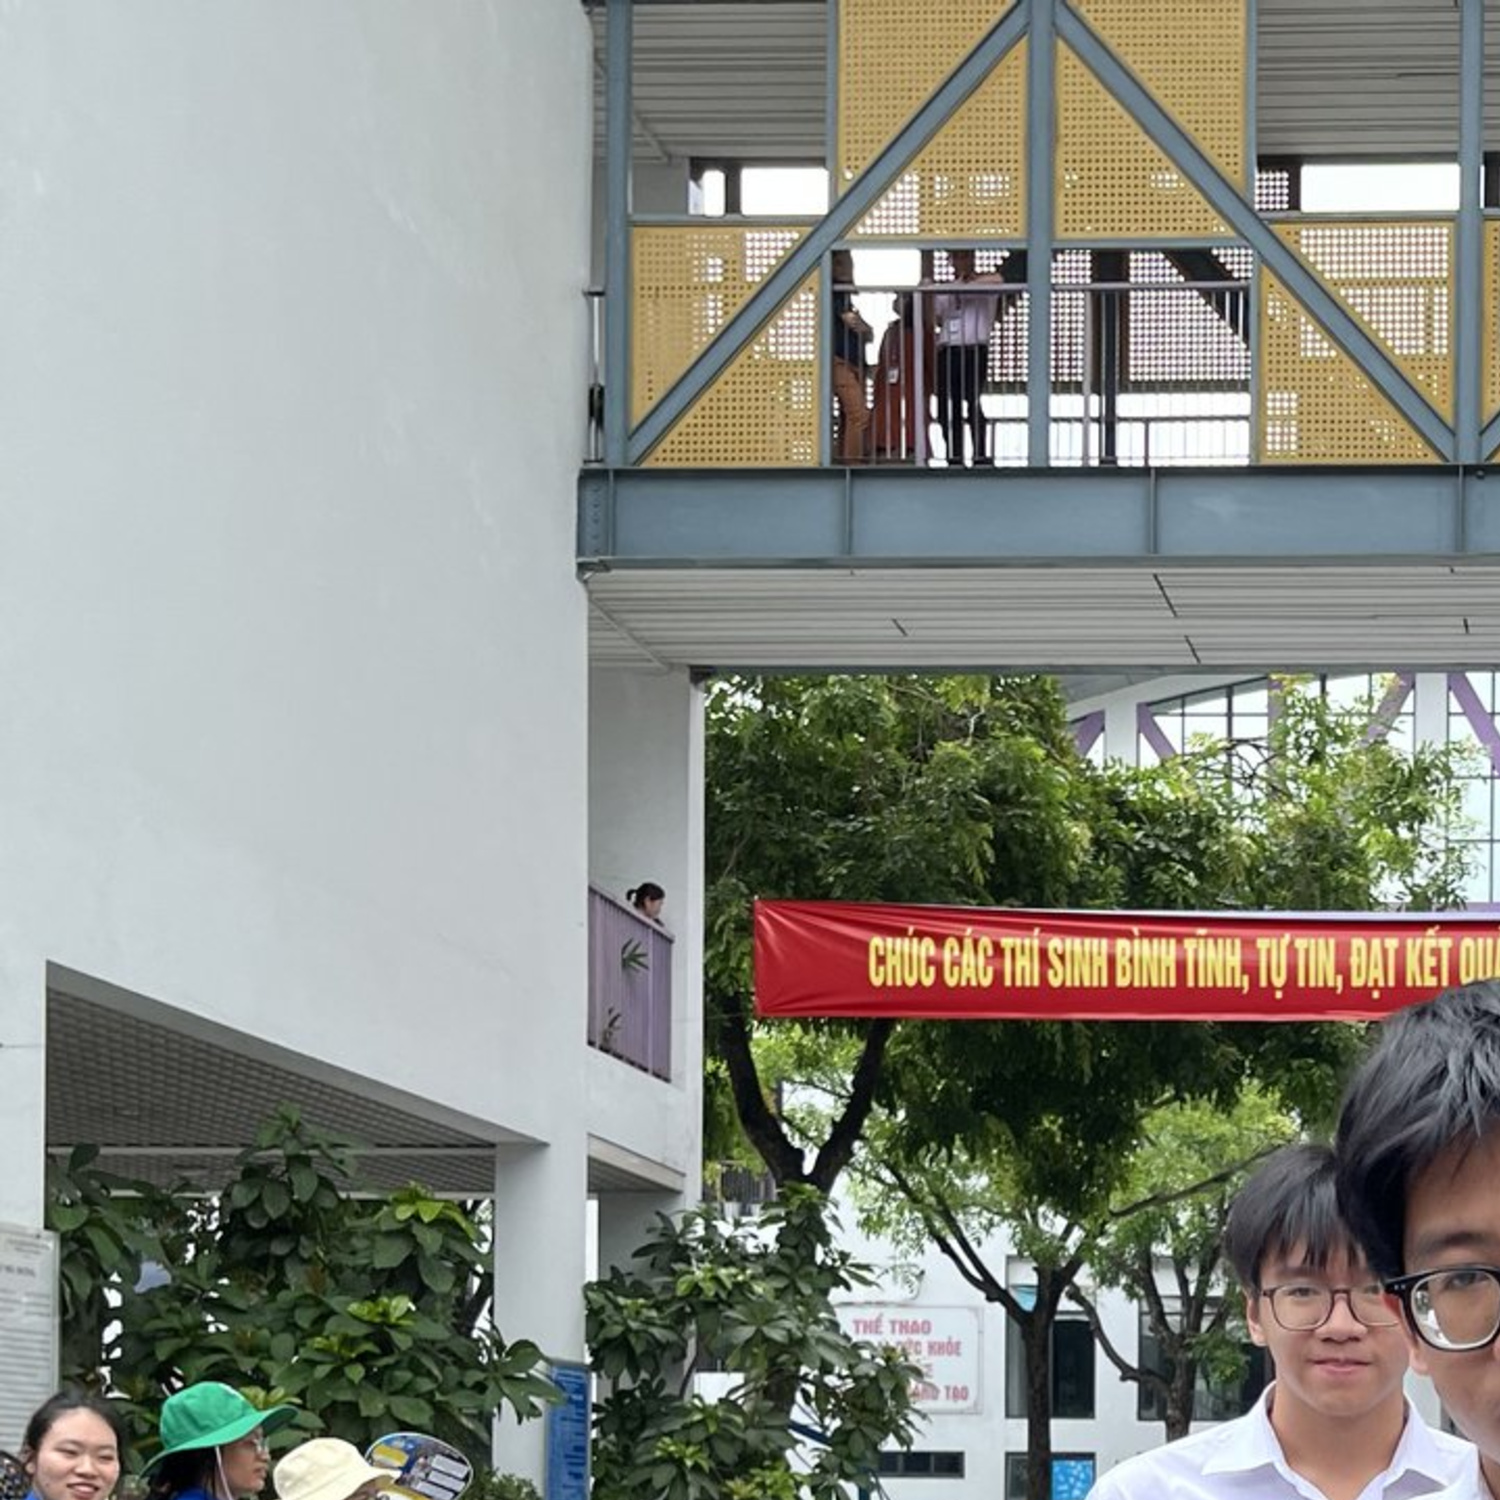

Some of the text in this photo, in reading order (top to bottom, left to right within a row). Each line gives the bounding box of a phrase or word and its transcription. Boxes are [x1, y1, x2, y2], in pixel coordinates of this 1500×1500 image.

[868, 926, 936, 987] CHÚC
[943, 927, 994, 987] CÁC
[1000, 927, 1041, 988] THÍ
[1047, 936, 1109, 988] SINH
[1115, 926, 1177, 988] BÌNH
[1184, 928, 1249, 994] TĨNH,
[1256, 932, 1291, 999] TỰ
[1294, 937, 1343, 994] TIN,
[1349, 936, 1399, 999] ĐẠT
[1405, 925, 1453, 988] KẾT
[889, 1319, 932, 1335] THAO
[944, 1385, 969, 1403] TẠO
